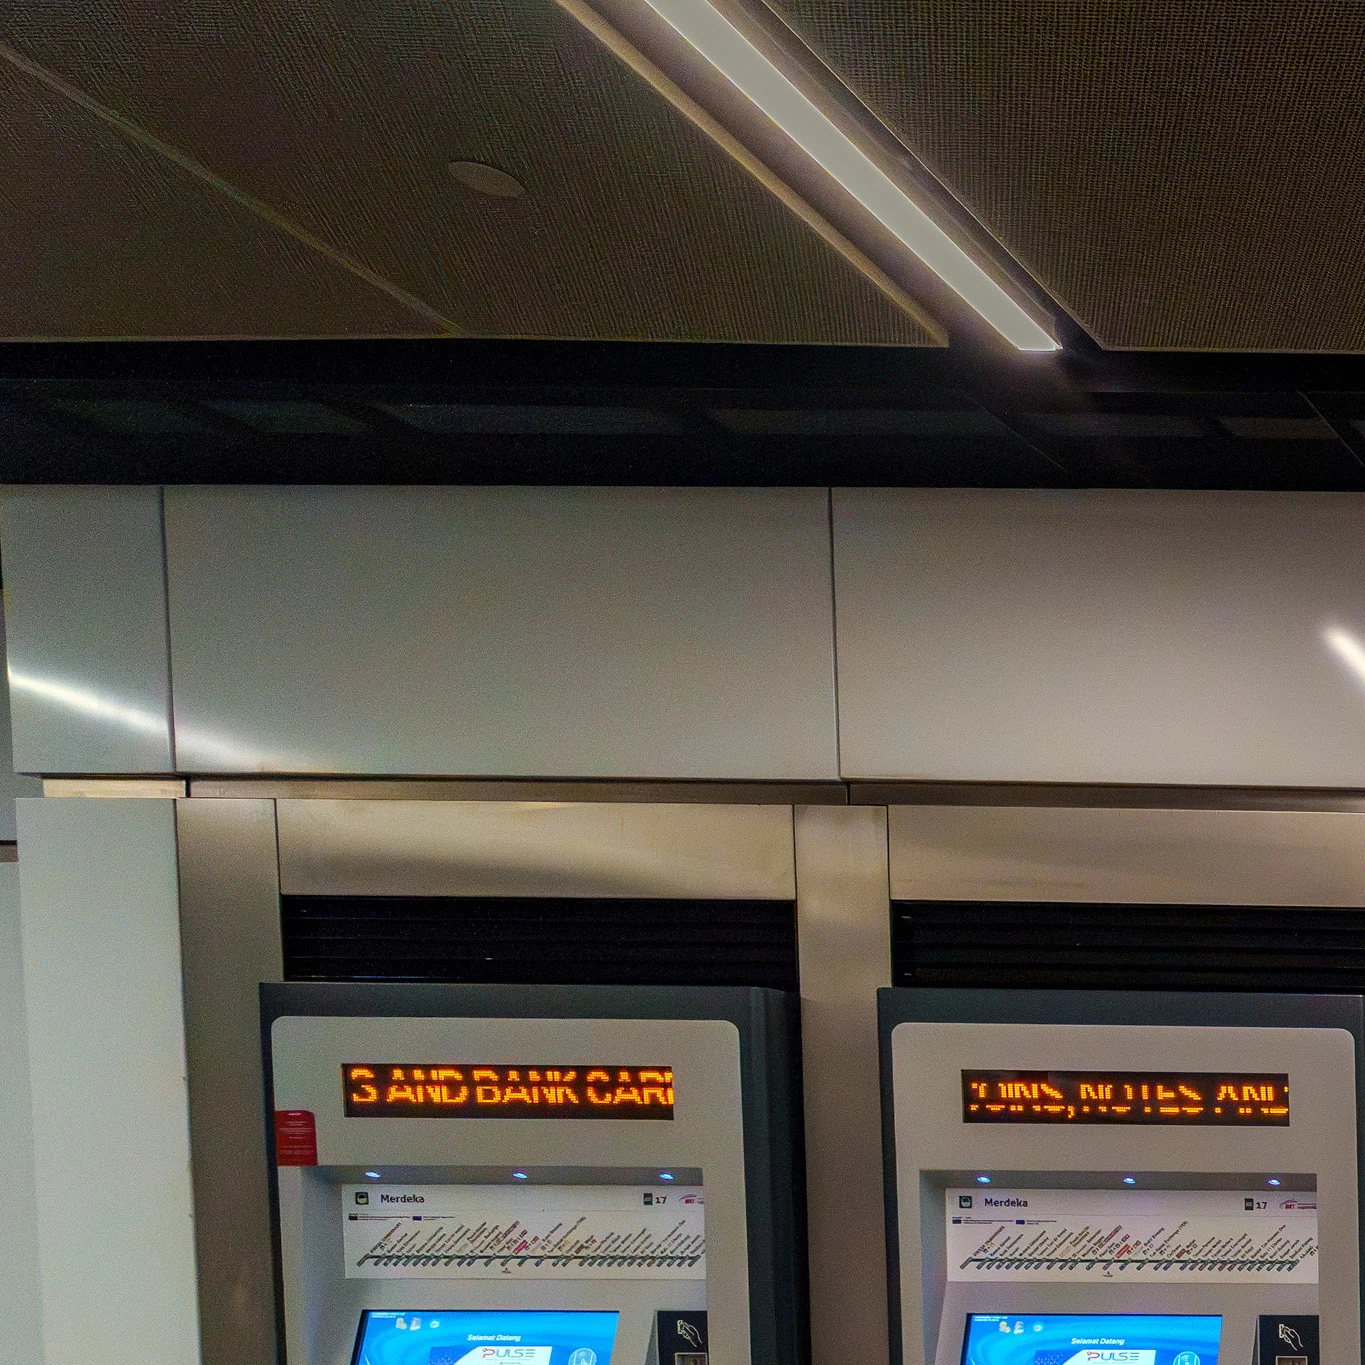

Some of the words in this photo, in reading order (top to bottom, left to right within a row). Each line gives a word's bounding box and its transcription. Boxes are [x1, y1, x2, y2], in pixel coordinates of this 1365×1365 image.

[387, 1067, 468, 1104] AND
[473, 1068, 579, 1104] BANK
[380, 1194, 425, 1203] Merdeka
[655, 1196, 667, 1204] 17
[984, 1198, 1029, 1208] Merdeka
[1255, 1201, 1268, 1210] 17
[1070, 1337, 1099, 1345] Selamat
[1100, 1337, 1125, 1347] Datang
[482, 1347, 536, 1359] PULSE
[1086, 1350, 1140, 1361] PULSE
